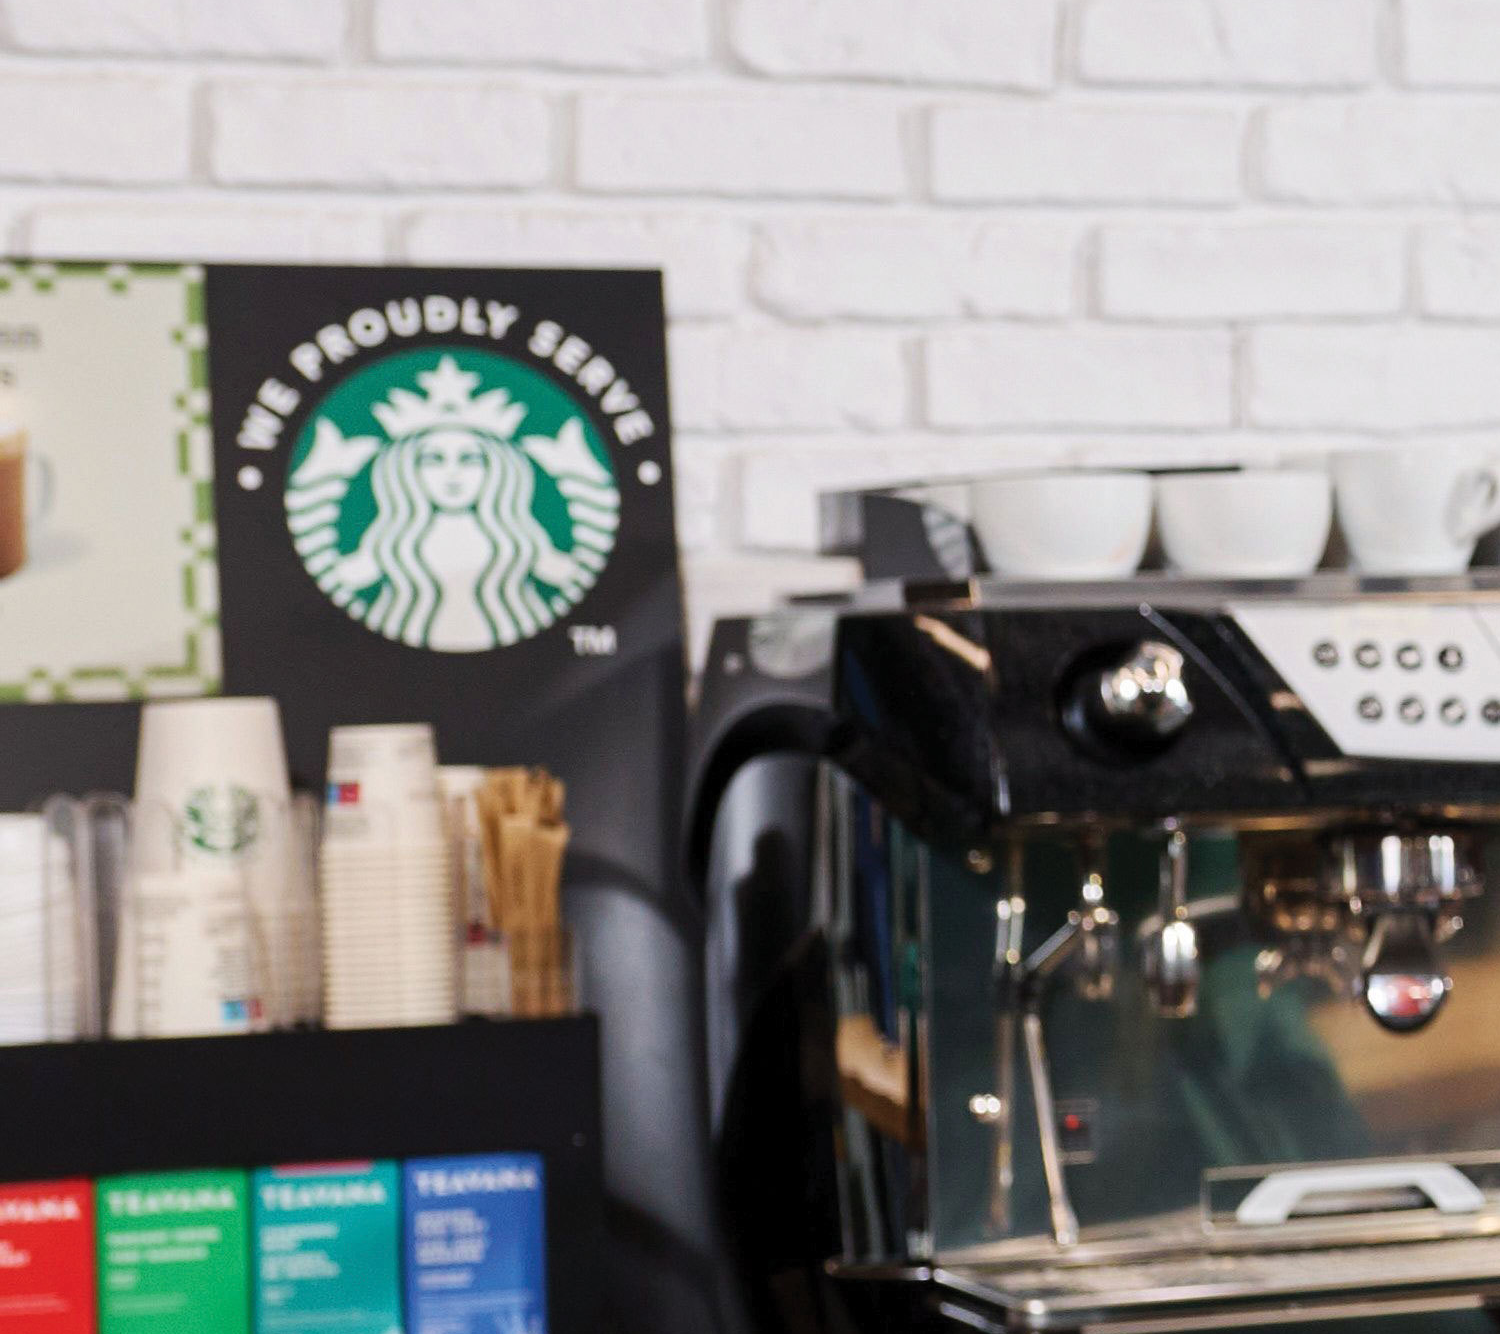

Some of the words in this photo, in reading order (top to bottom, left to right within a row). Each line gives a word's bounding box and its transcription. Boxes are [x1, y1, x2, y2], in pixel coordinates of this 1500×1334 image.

[237, 378, 300, 451] WE
[289, 295, 519, 383] PROUDLY
[528, 320, 654, 445] SERVE
